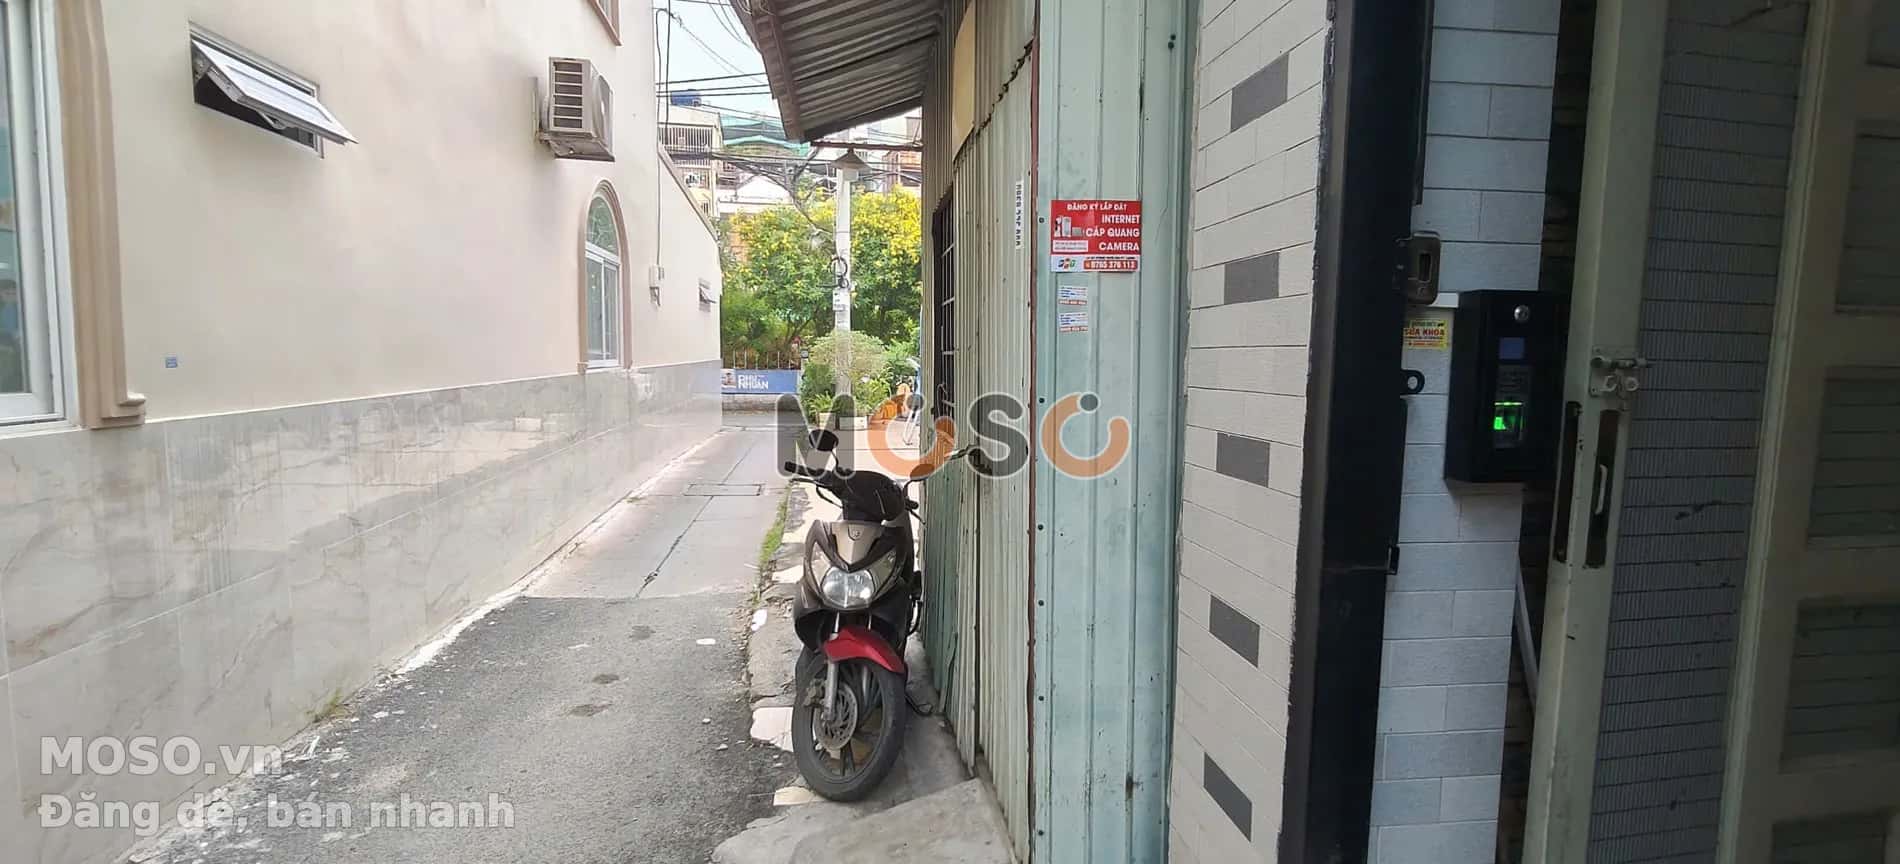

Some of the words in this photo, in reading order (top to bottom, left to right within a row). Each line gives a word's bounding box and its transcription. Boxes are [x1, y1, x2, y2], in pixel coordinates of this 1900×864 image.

[1101, 214, 1141, 224] INTERNET
[1085, 226, 1106, 237] CÁP
[1107, 227, 1140, 237] QUANG
[1098, 242, 1140, 251] CAMERA
